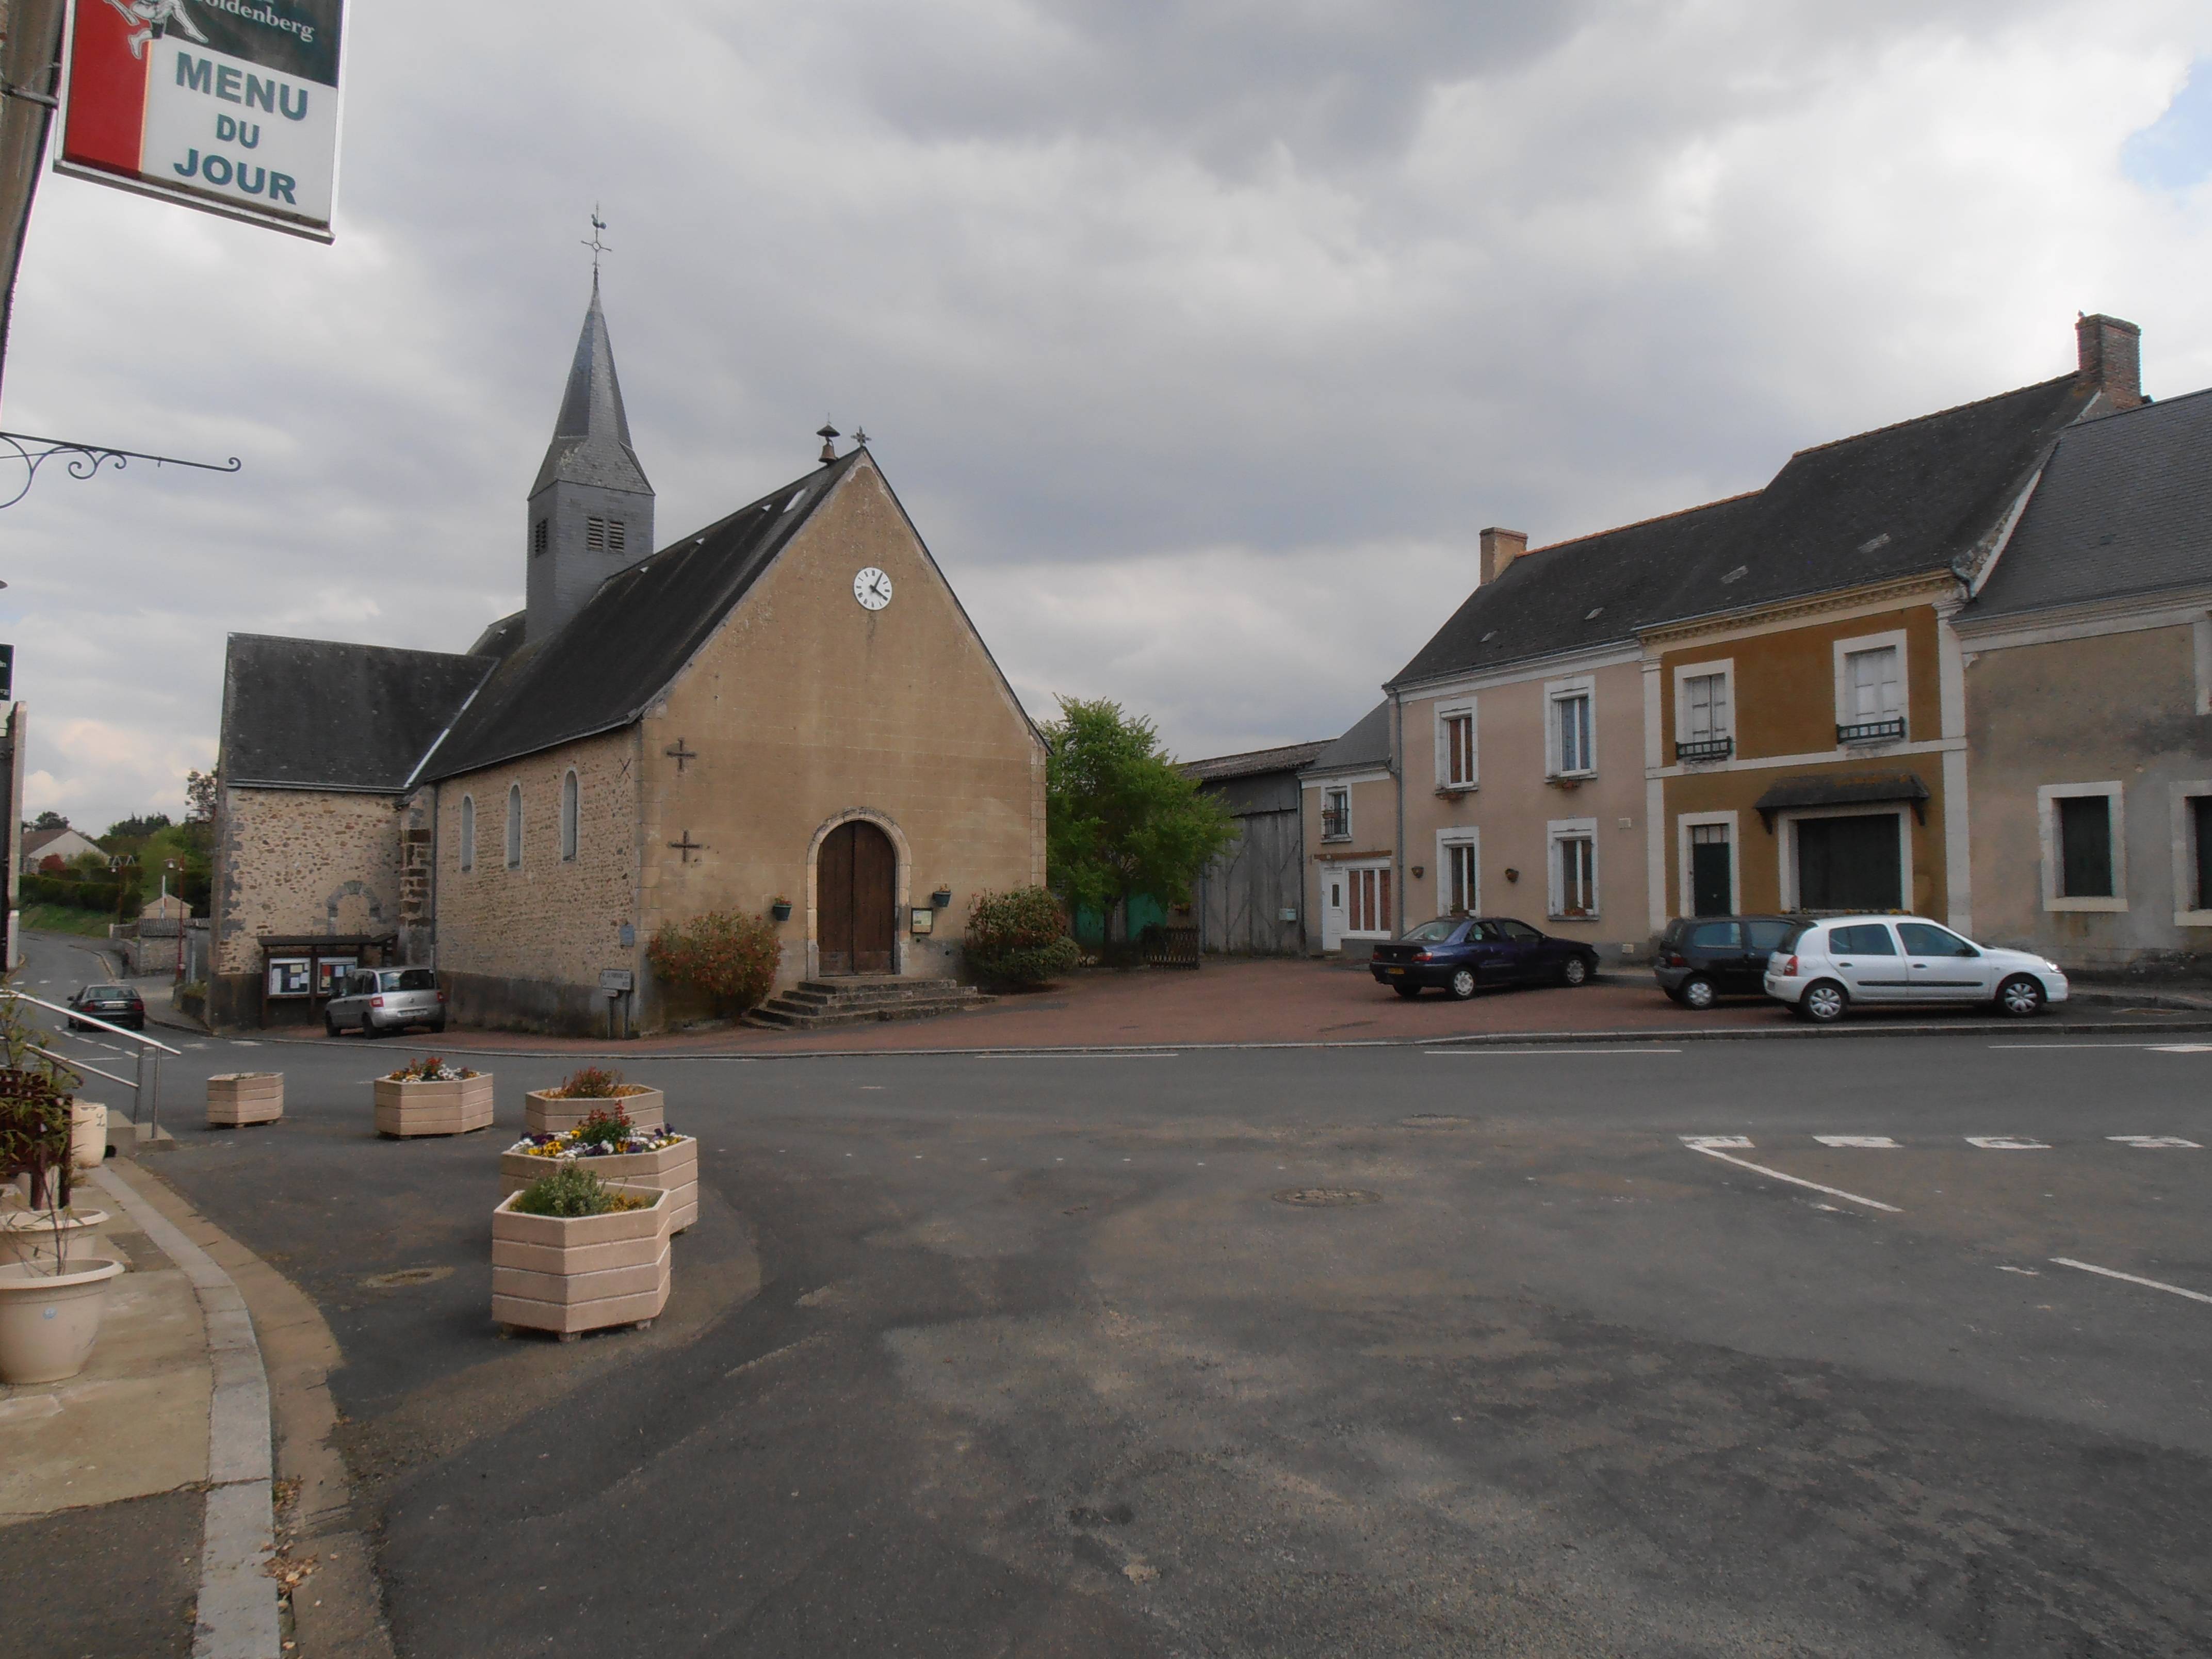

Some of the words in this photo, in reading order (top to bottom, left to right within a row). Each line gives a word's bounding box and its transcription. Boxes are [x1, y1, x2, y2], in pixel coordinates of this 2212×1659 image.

[196, 0, 315, 43] oldenberg
[175, 52, 309, 122] MENU
[215, 113, 261, 150] DU
[173, 148, 297, 205] JOUR
